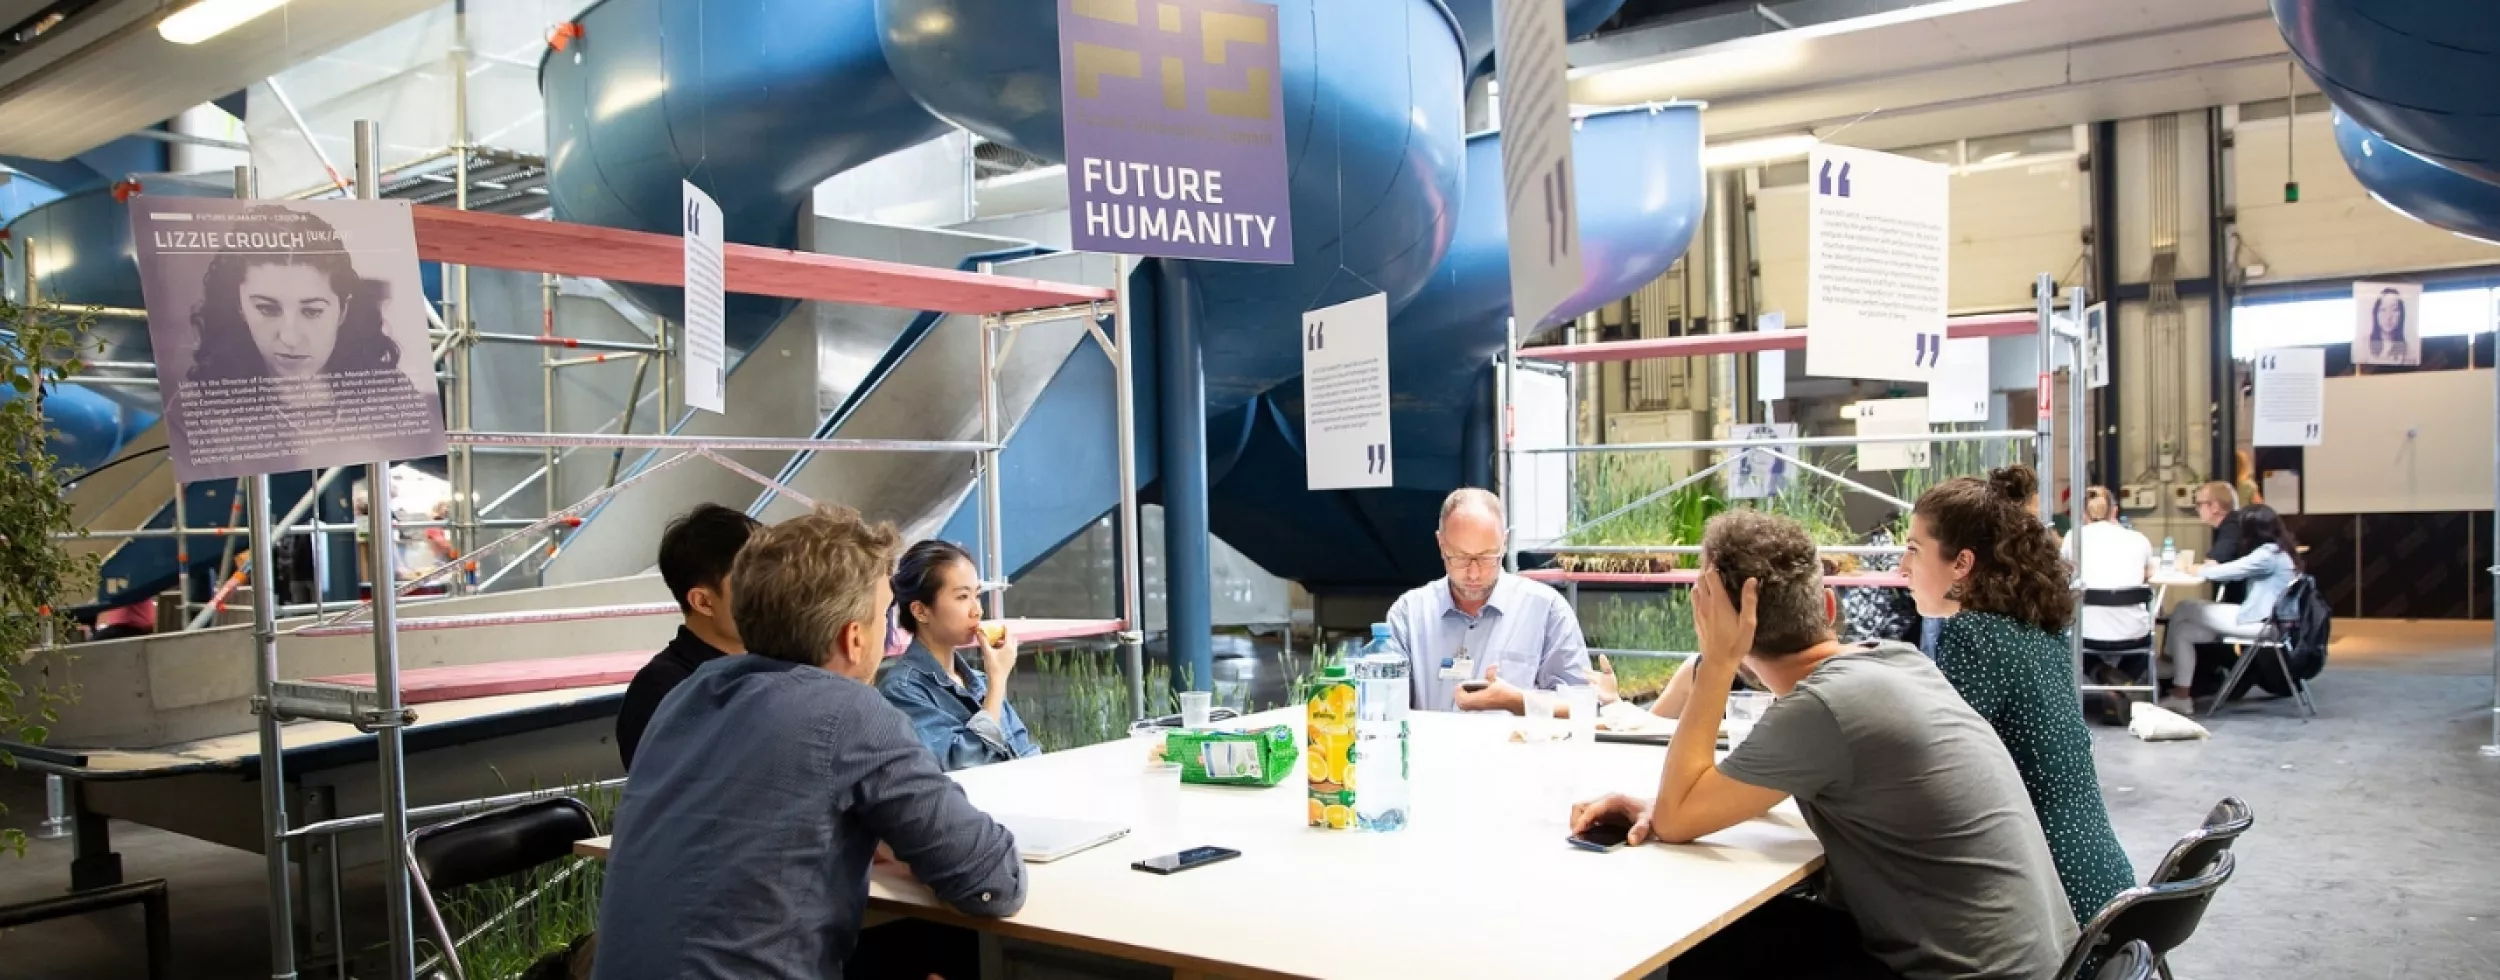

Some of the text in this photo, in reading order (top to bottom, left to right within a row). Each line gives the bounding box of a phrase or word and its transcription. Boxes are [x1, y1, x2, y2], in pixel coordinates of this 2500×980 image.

[1083, 157, 1277, 248] FUTURE HUMANITY
[154, 231, 220, 248] LIZZIE
[223, 231, 304, 248] CROUCH
